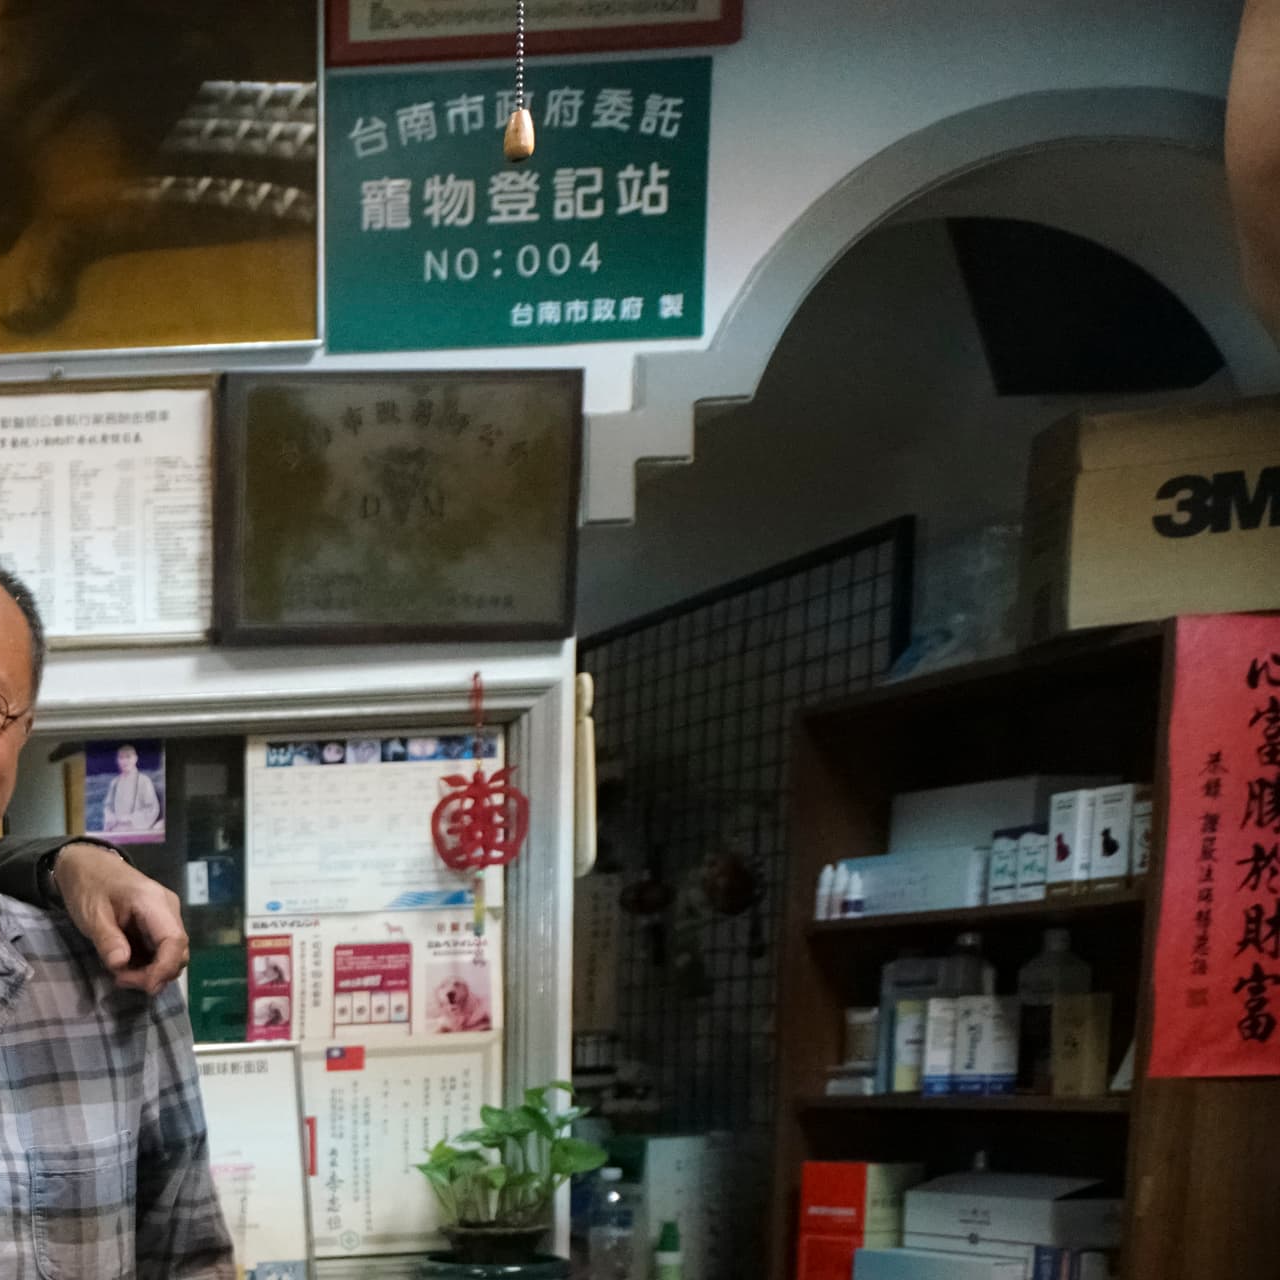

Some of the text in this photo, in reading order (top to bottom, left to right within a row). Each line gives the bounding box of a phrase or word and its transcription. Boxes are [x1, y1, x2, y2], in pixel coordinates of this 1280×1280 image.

[360, 162, 671, 232] 寵物登記站
[423, 241, 603, 283] NO:004
[1151, 469, 1280, 539] 3M
